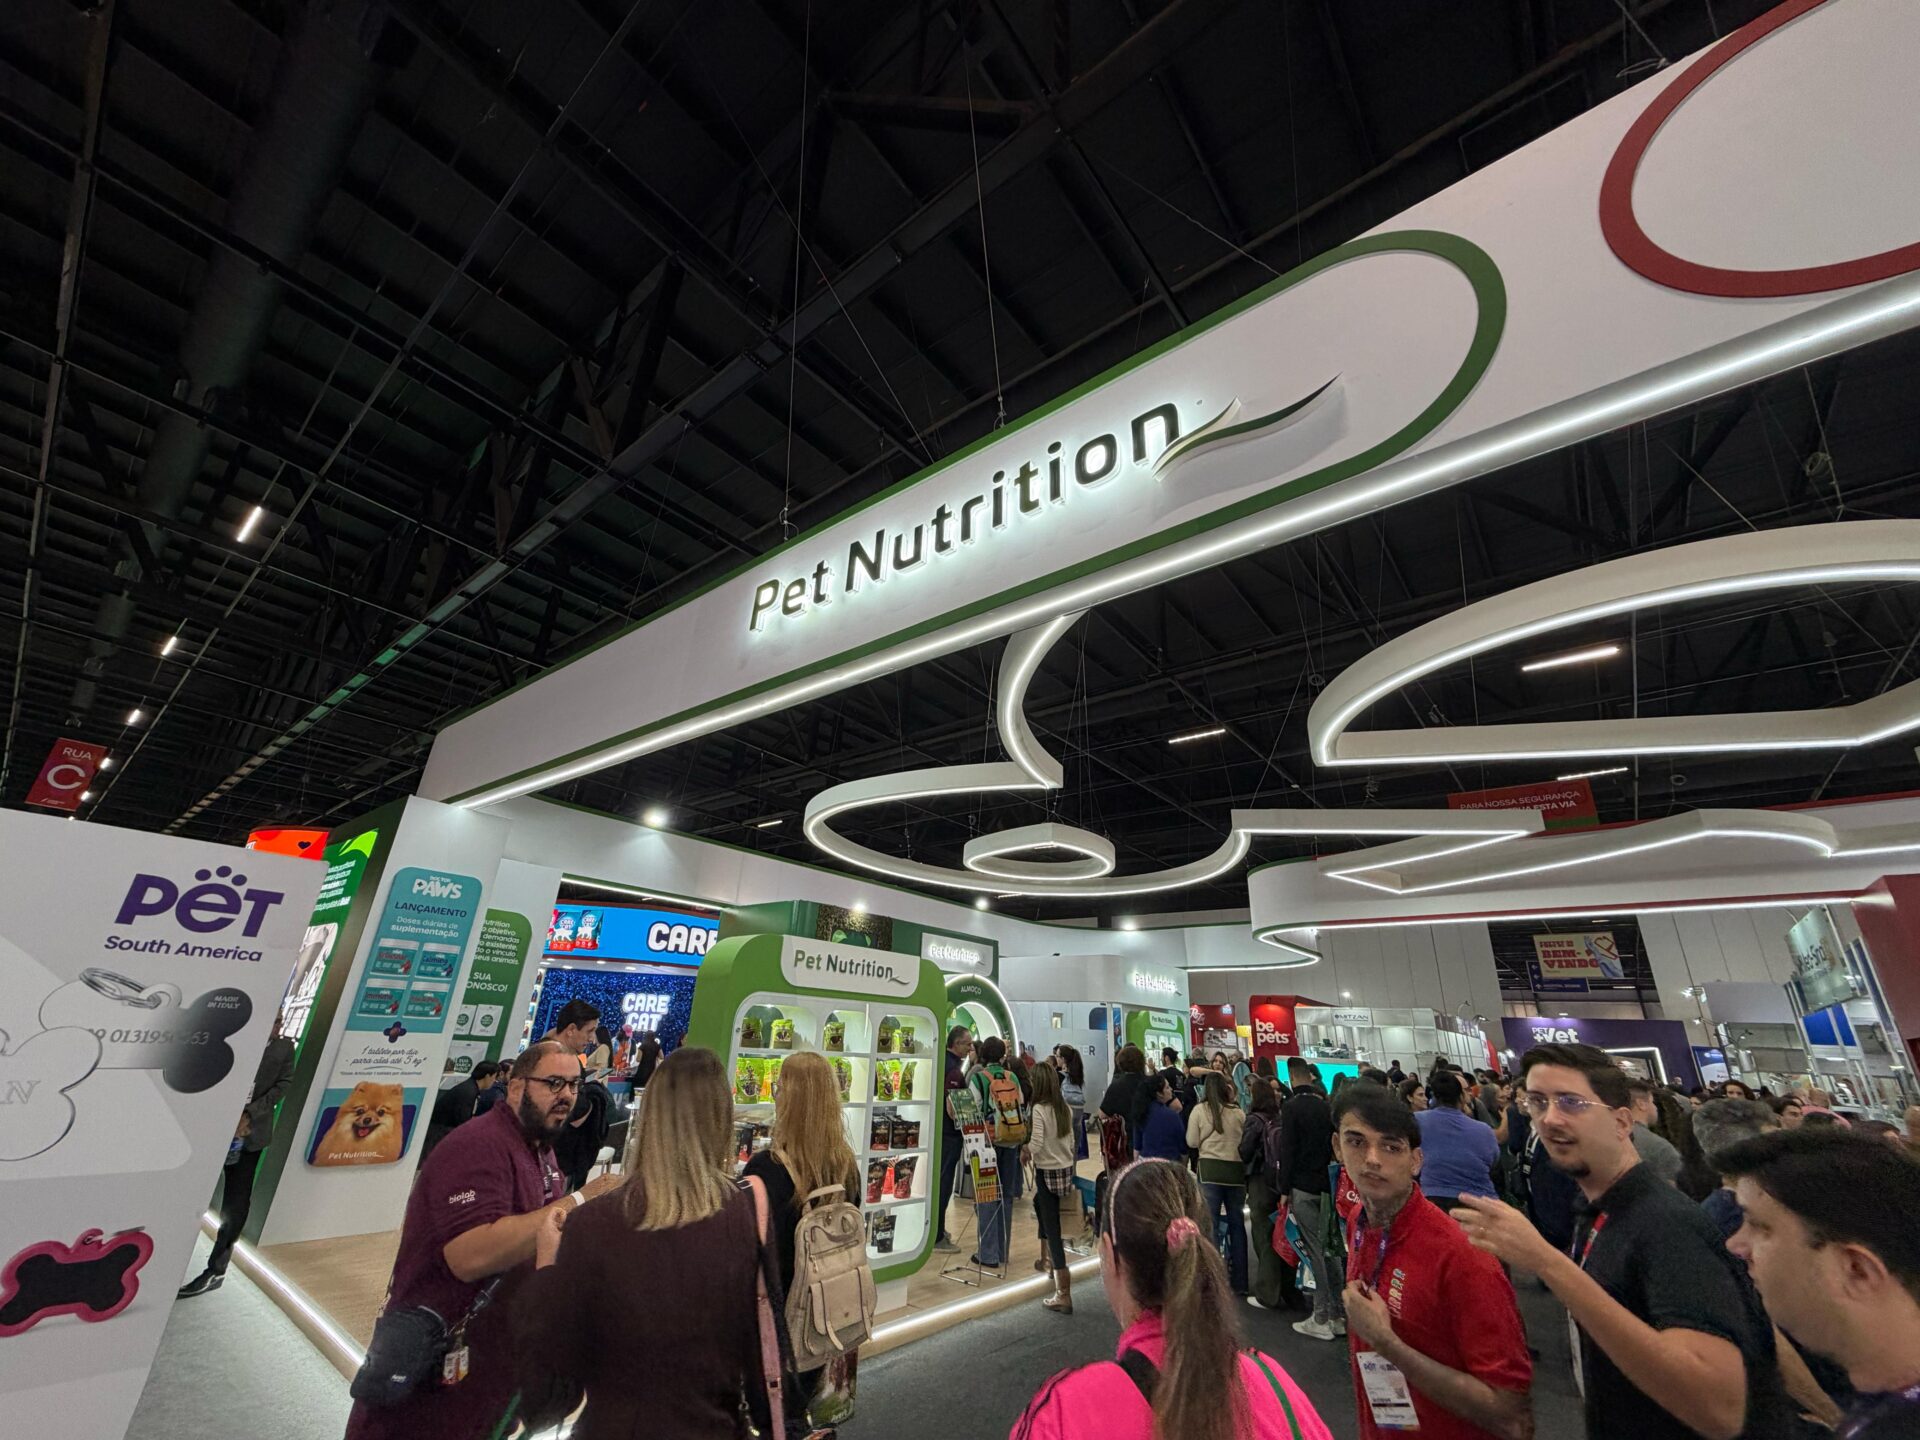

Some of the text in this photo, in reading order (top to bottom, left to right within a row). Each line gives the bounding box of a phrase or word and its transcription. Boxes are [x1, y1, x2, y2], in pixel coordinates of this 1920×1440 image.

[749, 401, 1180, 632] Pet Nutrition
[62, 747, 92, 760] RUA
[46, 764, 86, 790] C
[1484, 799, 1518, 808] NOSSA
[1519, 790, 1581, 804] SEGURANÇA
[1560, 800, 1577, 808] VIA
[412, 878, 463, 899] PAWS
[394, 901, 467, 918] LANÇAMENTO
[396, 916, 420, 925] Doses
[422, 919, 447, 929] diárias
[390, 924, 459, 938] suplementação
[104, 935, 263, 962] South America
[794, 949, 893, 979] Pet Nutrition
[473, 971, 492, 981] SUA
[960, 985, 982, 996] ALMOÇO
[622, 993, 670, 1014] CARE
[626, 1013, 662, 1032] CAT
[1255, 1018, 1275, 1032] be
[1257, 1031, 1289, 1046] pets
[328, 1151, 377, 1160] Pet Nutrition
[449, 1190, 476, 1203] biolab
